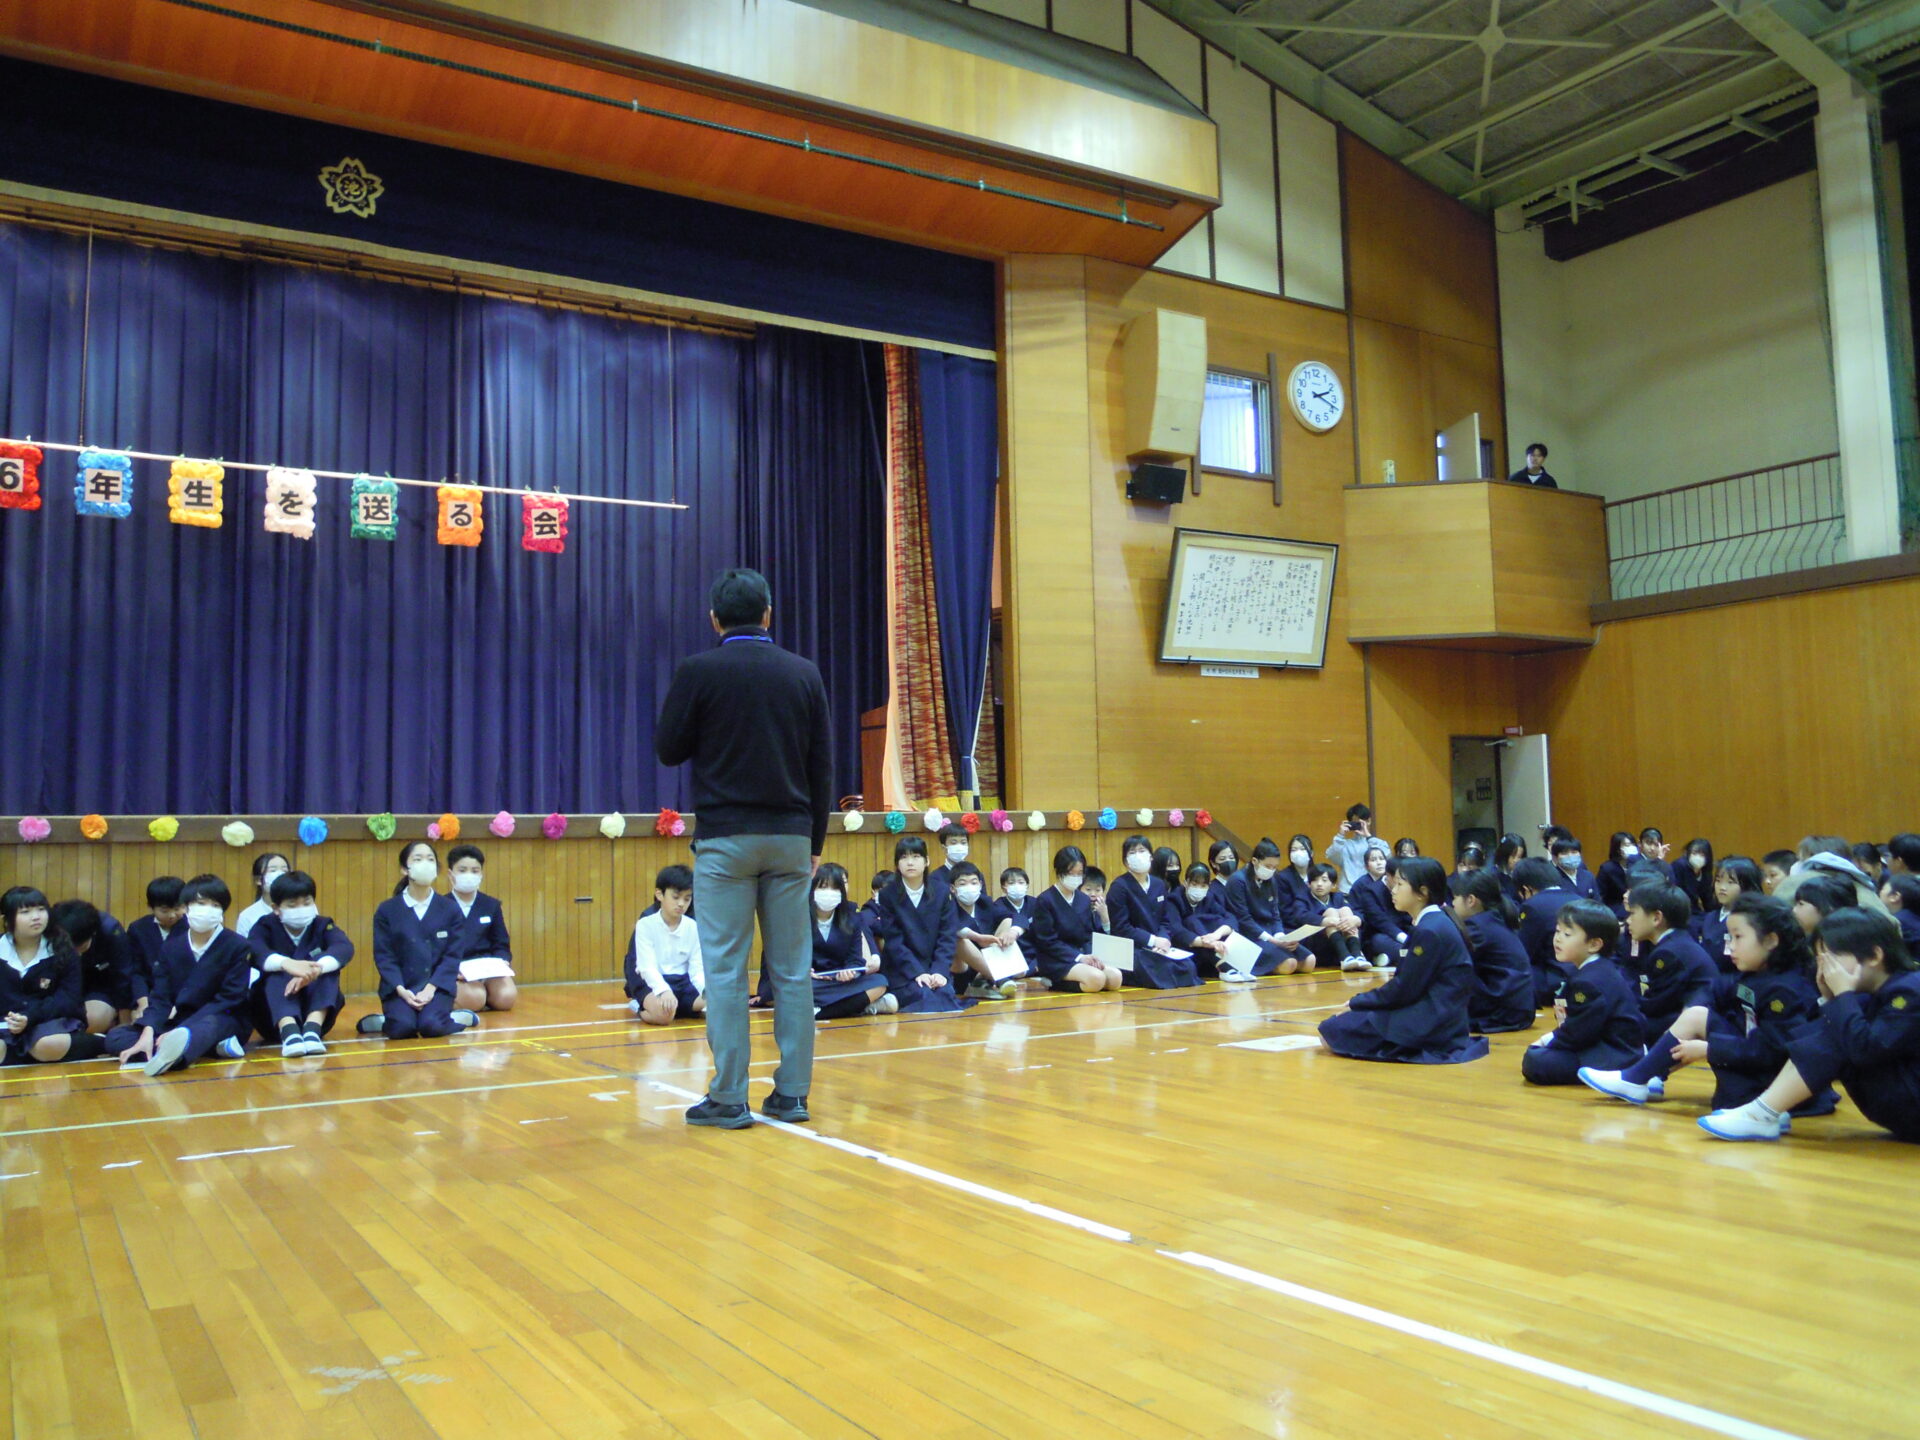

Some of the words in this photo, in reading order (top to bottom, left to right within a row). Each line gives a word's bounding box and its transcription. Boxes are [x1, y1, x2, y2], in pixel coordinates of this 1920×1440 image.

[1304, 370, 1311, 379] 11
[1312, 369, 1320, 378] 12
[1298, 379, 1307, 388] 10
[1323, 375, 1327, 383] 1
[1328, 383, 1334, 392] 2
[1297, 389, 1303, 398] 9
[1331, 395, 1337, 404] 3
[1300, 400, 1306, 410] 8
[1307, 409, 1313, 418] 7
[1323, 412, 1329, 421] 5
[1315, 414, 1321, 423] 6
[0, 461, 20, 490] 6
[89, 472, 121, 501] 年
[184, 480, 214, 508] 生
